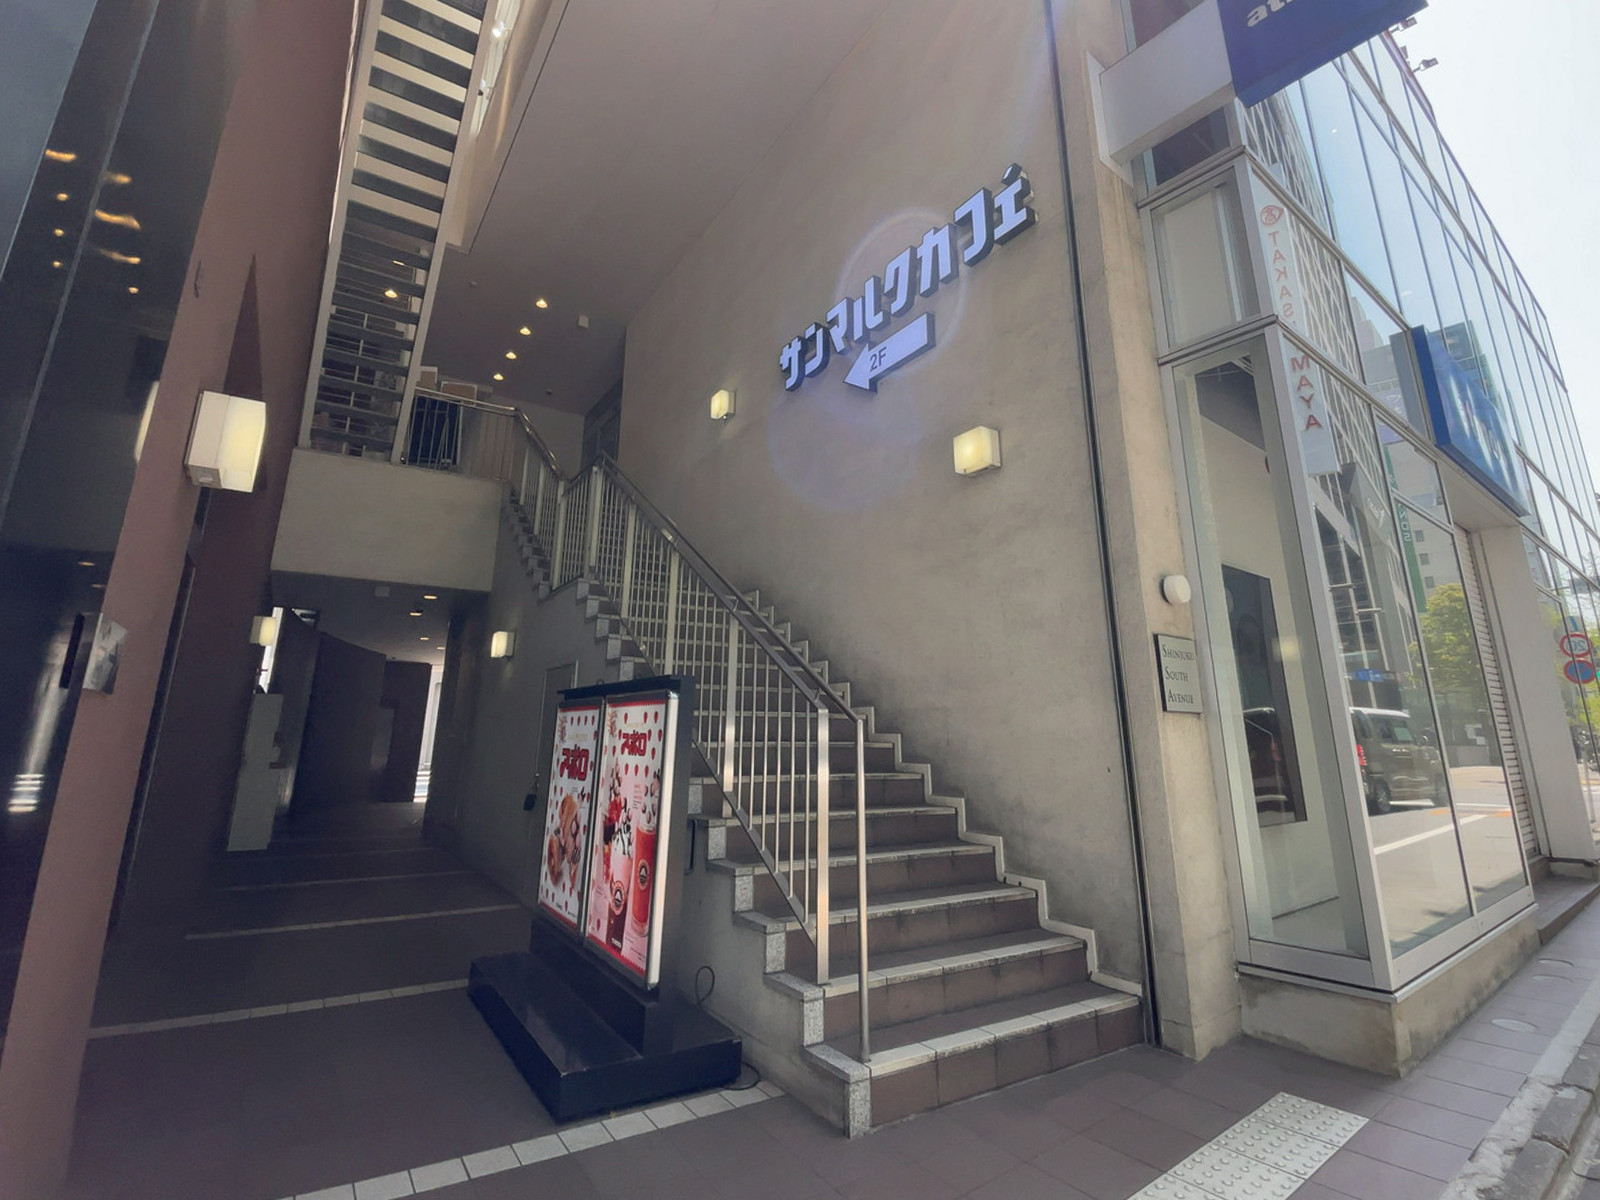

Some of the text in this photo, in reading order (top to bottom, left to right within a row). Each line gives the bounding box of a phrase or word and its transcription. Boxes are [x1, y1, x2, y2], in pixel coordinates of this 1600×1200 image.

[1247, 0, 1293, 27] at
[779, 164, 1031, 391] サンマルクカフェ
[869, 346, 887, 371] 2F
[1164, 666, 1189, 682] SOUTH
[1168, 689, 1194, 704] AVENUE
